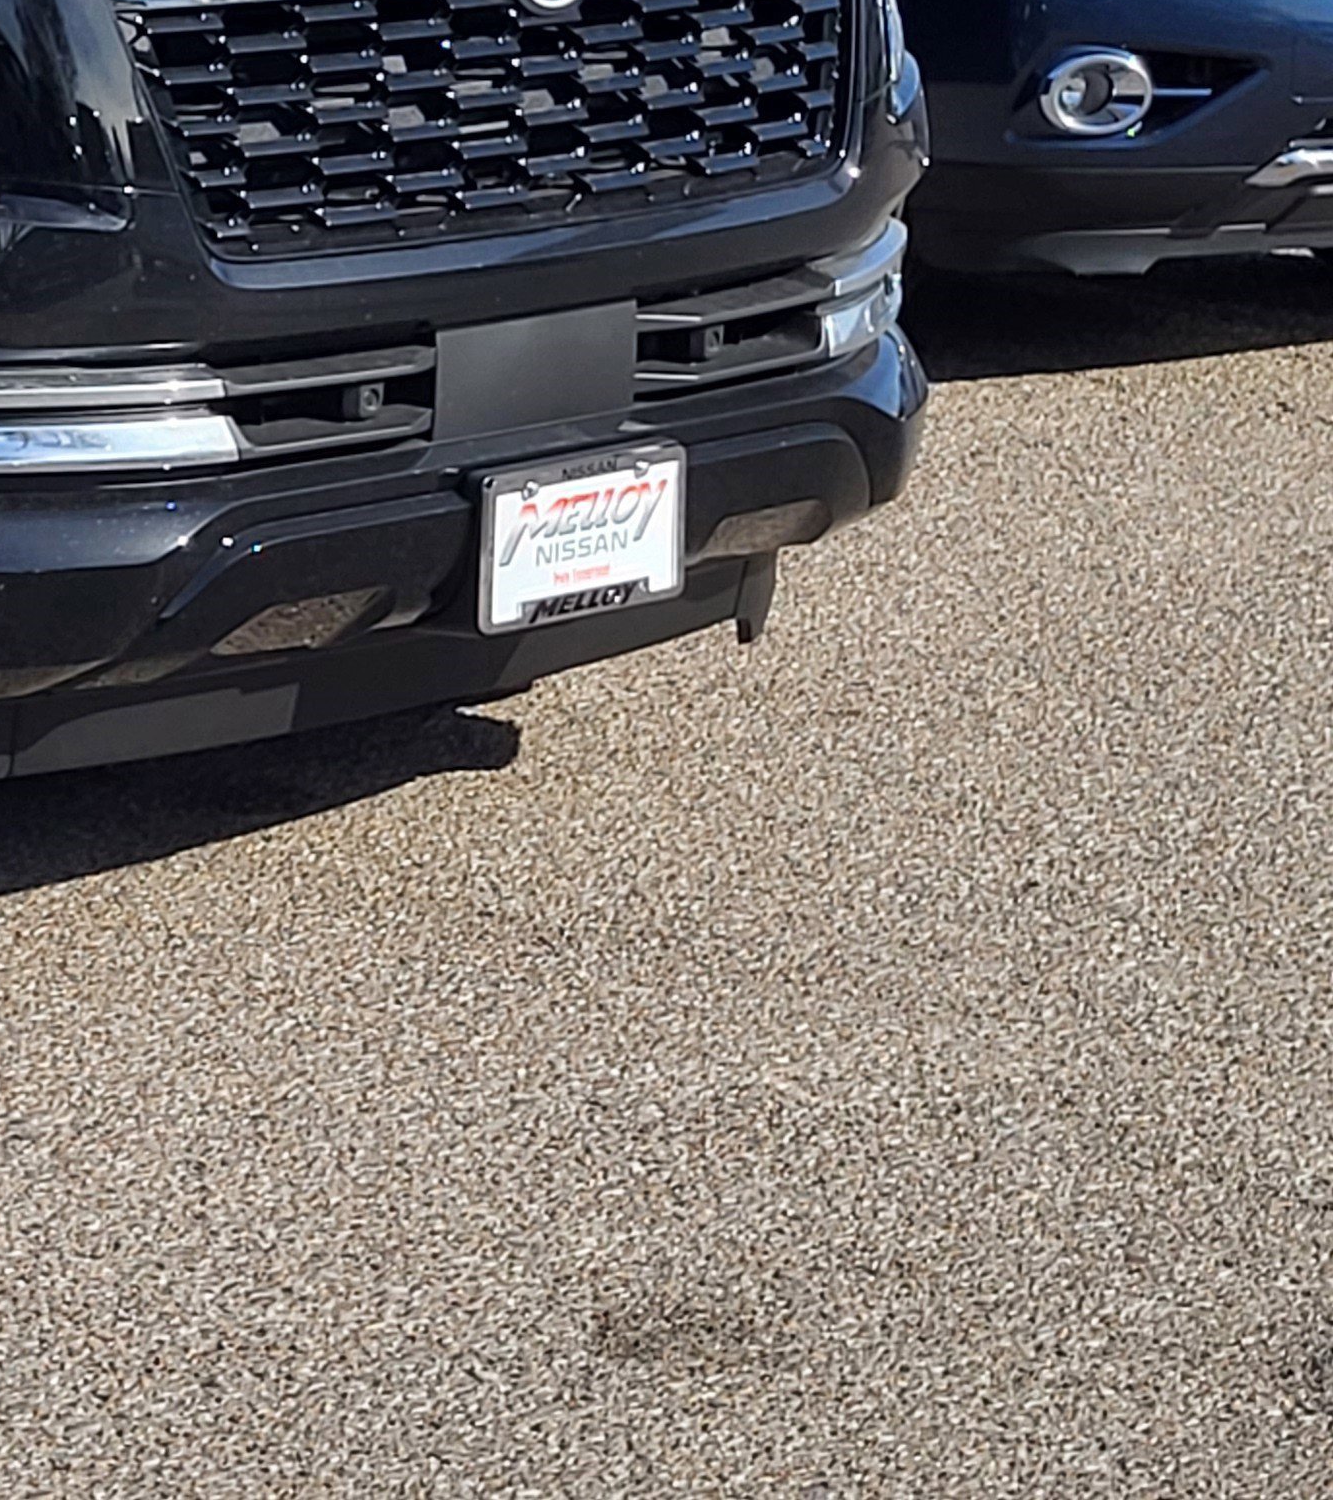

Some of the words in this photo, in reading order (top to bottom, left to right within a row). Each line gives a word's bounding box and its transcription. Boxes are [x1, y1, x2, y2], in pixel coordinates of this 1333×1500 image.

[563, 457, 618, 479] NISSAN
[499, 480, 667, 567] MELLOY
[536, 530, 628, 566] NISSAN
[529, 581, 637, 623] MELLOY
